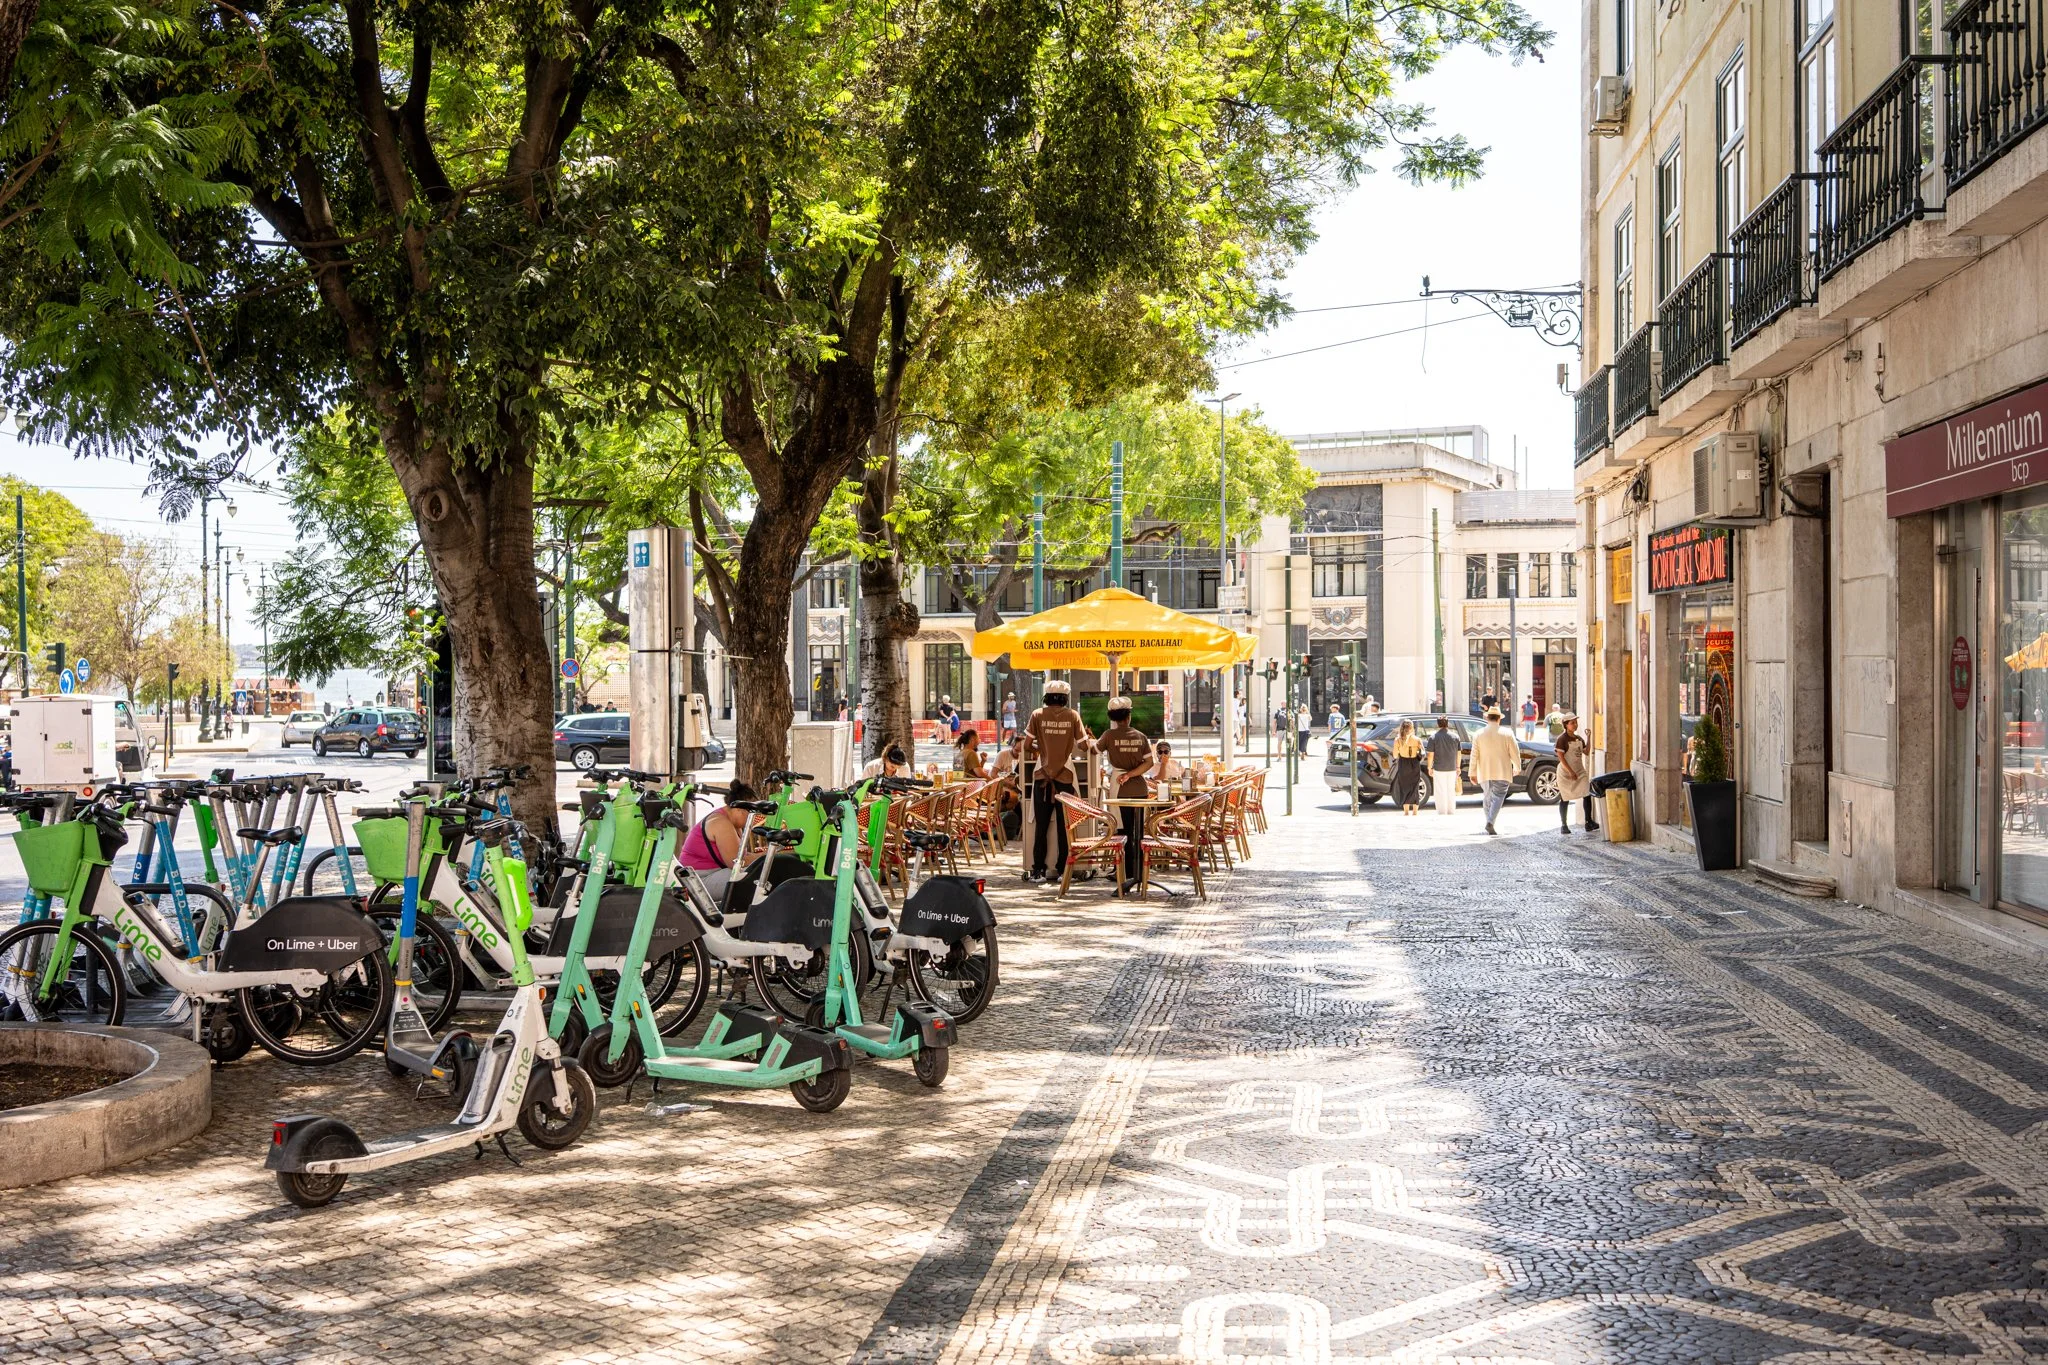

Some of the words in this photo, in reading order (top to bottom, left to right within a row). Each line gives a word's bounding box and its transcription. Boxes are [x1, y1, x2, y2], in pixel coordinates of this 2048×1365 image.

[1945, 409, 2043, 471] Millennium
[2011, 459, 2029, 485] bcp
[1652, 545, 1693, 590] PORTUGUESE
[1695, 536, 1726, 583] SARDINE
[1024, 640, 1044, 650] CASA
[1048, 639, 1102, 650] PORTUGUESA
[1105, 639, 1137, 649] PASTEL
[1140, 638, 1183, 648] BACALHAU
[335, 855, 349, 886] BIRD
[591, 851, 607, 875] Bolt
[653, 861, 670, 885] Bolt
[841, 847, 853, 869] Bolt
[170, 868, 187, 909] BIRD
[228, 867, 244, 903] BIRD
[114, 907, 162, 960] Lime
[202, 916, 218, 951] Lime
[453, 896, 498, 949] Lime
[917, 909, 926, 919] On
[926, 910, 943, 921] Lime
[950, 913, 970, 925] Uber
[267, 939, 284, 950] On
[286, 939, 316, 950] Lime
[317, 940, 325, 948] +
[327, 939, 358, 950] Uber
[506, 1047, 532, 1105] Lime
